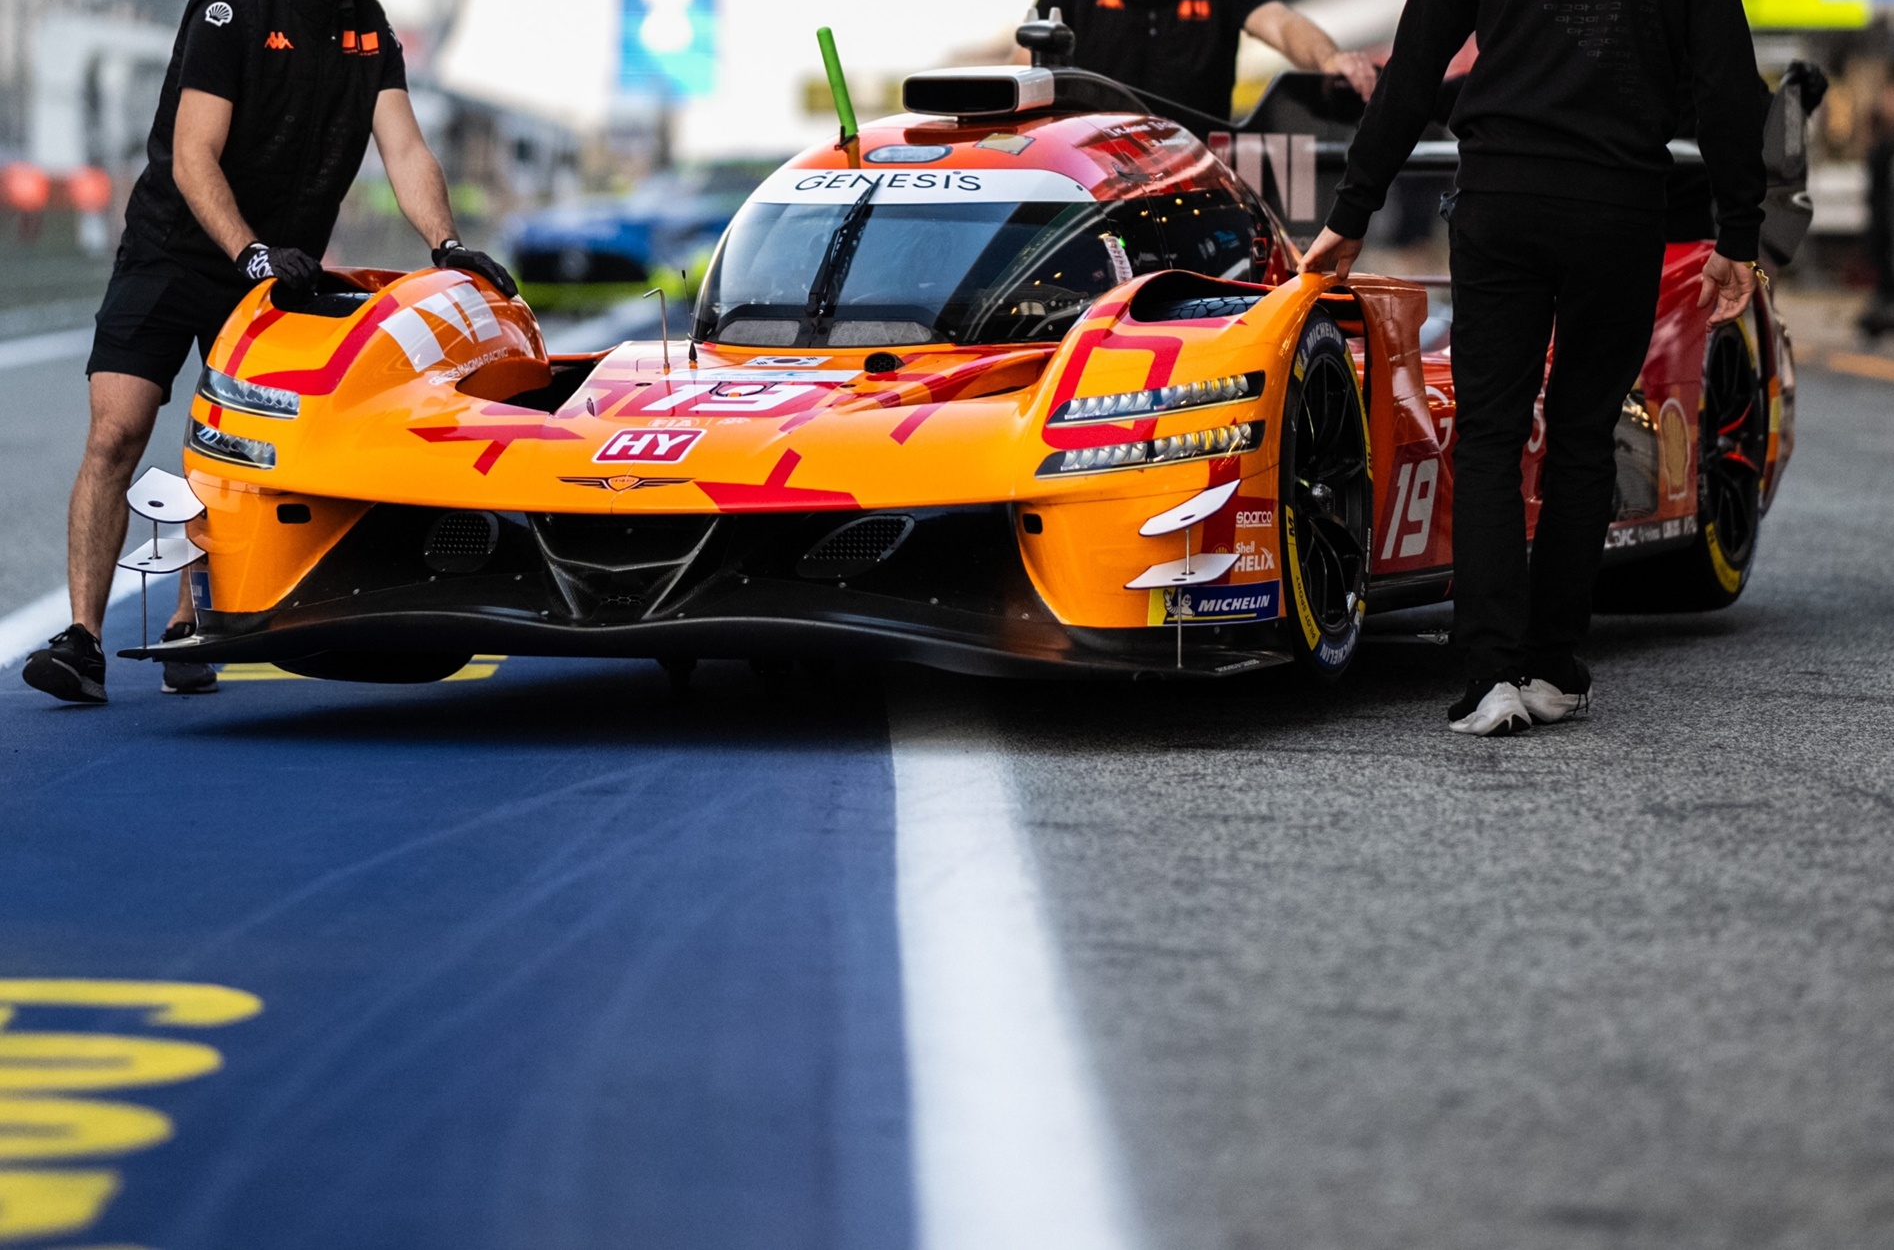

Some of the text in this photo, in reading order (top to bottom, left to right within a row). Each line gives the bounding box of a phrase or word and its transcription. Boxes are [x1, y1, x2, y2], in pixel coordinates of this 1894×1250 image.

[794, 172, 982, 192] GENESIS
[482, 347, 509, 365] RACING
[650, 418, 692, 428] FIA
[605, 433, 693, 455] HY
[1236, 510, 1272, 526] sparco
[1381, 458, 1439, 560] 19
[1236, 541, 1256, 554] Shell
[1235, 547, 1275, 573] HELIX
[1198, 595, 1271, 612] MICHELIN
